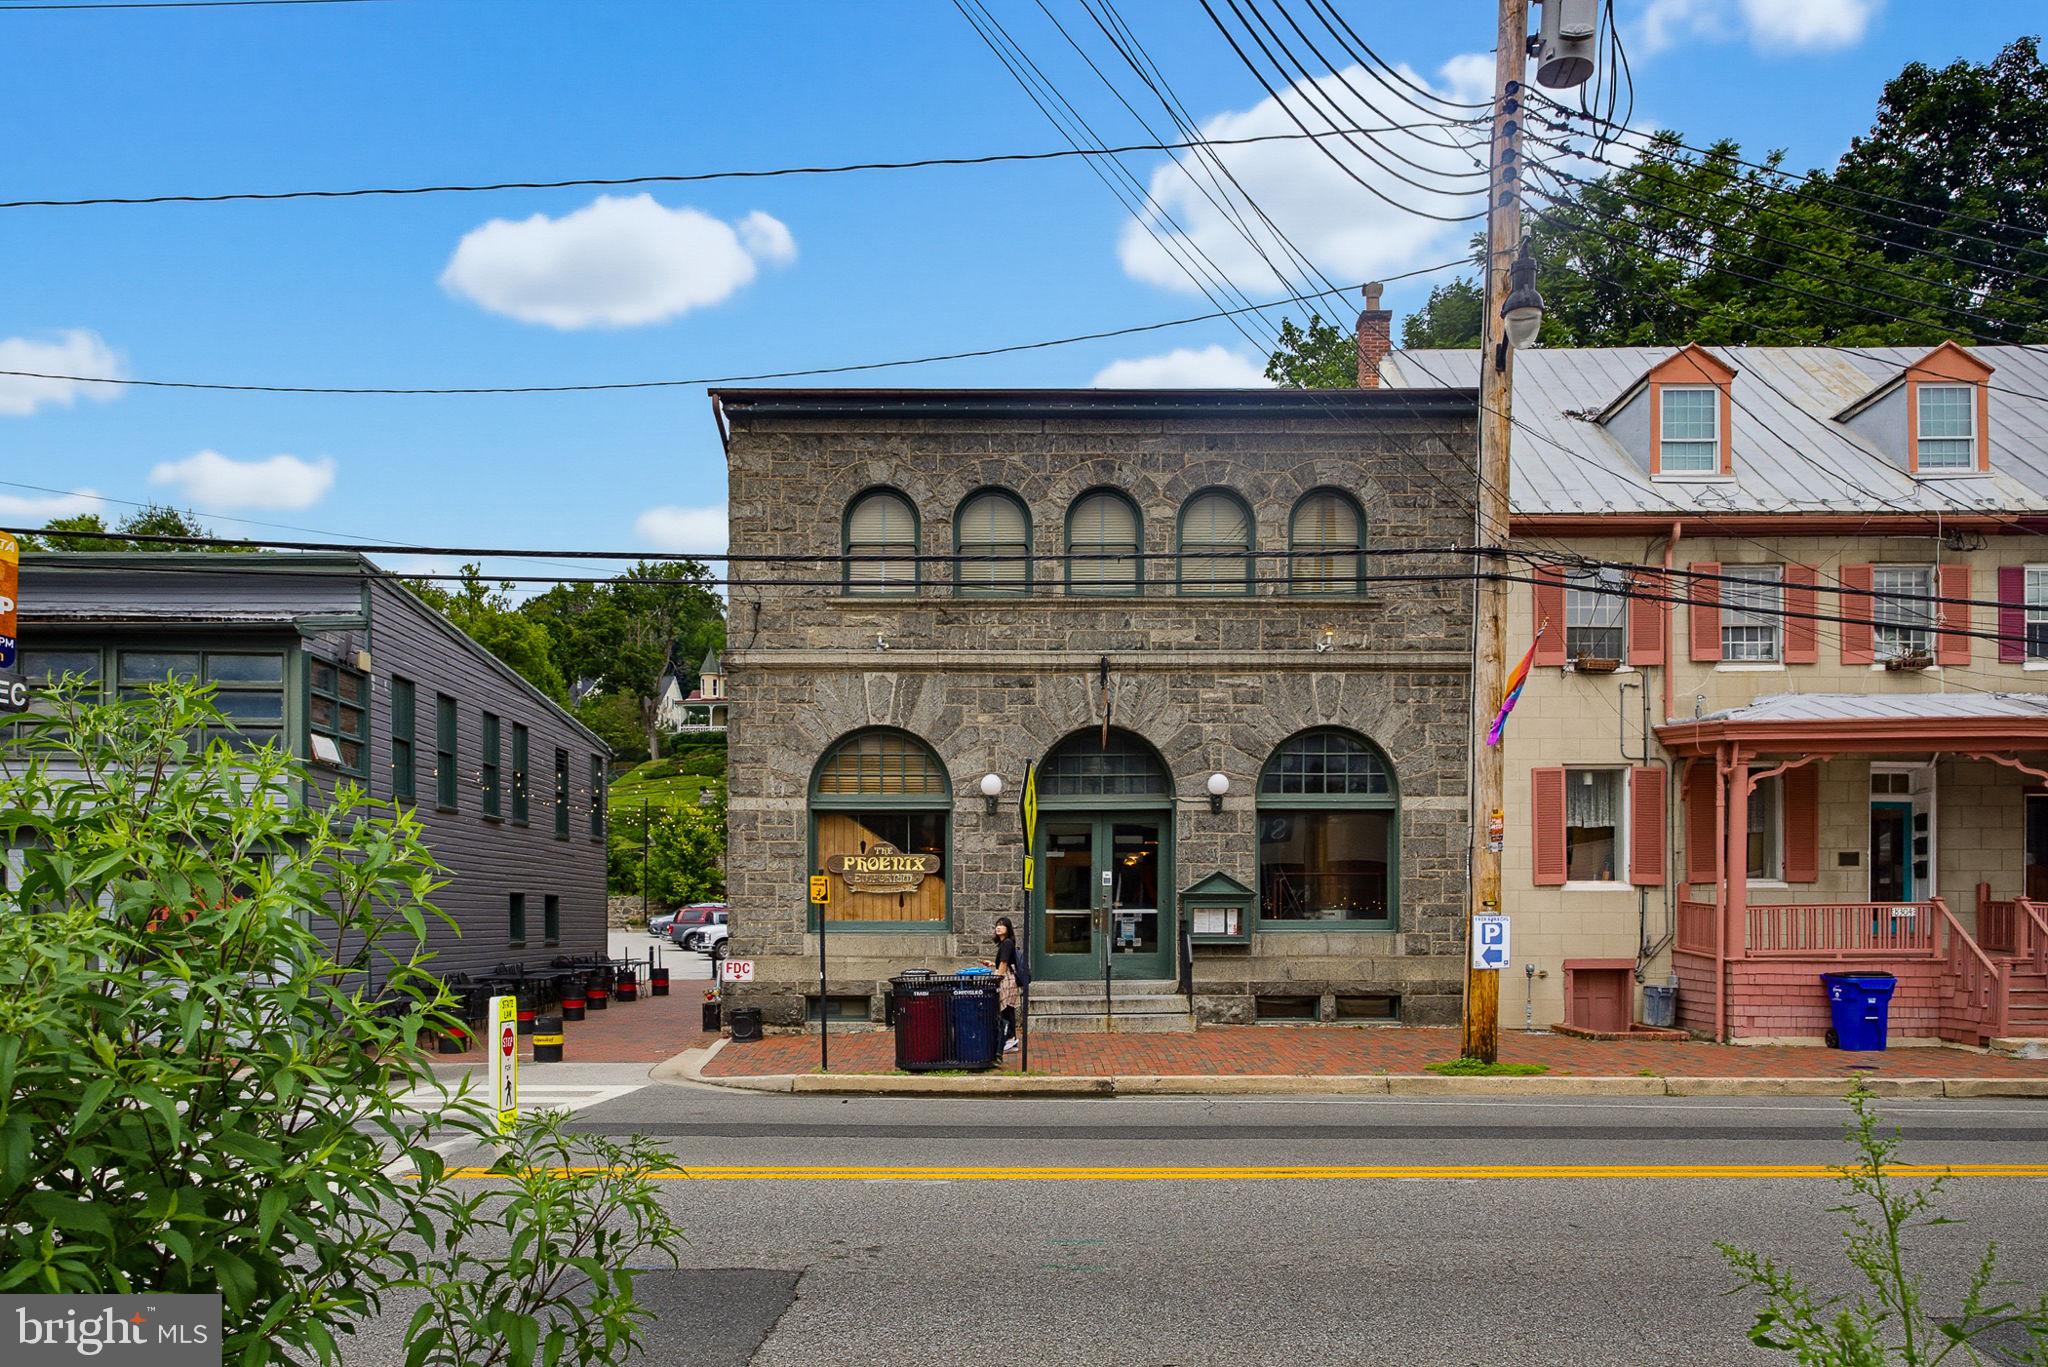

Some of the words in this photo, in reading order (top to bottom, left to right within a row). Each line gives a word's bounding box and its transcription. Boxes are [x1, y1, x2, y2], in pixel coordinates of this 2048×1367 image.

[874, 846, 894, 855] THE
[843, 856, 926, 872] PHOENIX
[726, 962, 750, 974] FDC
[502, 1036, 513, 1048] STOP
